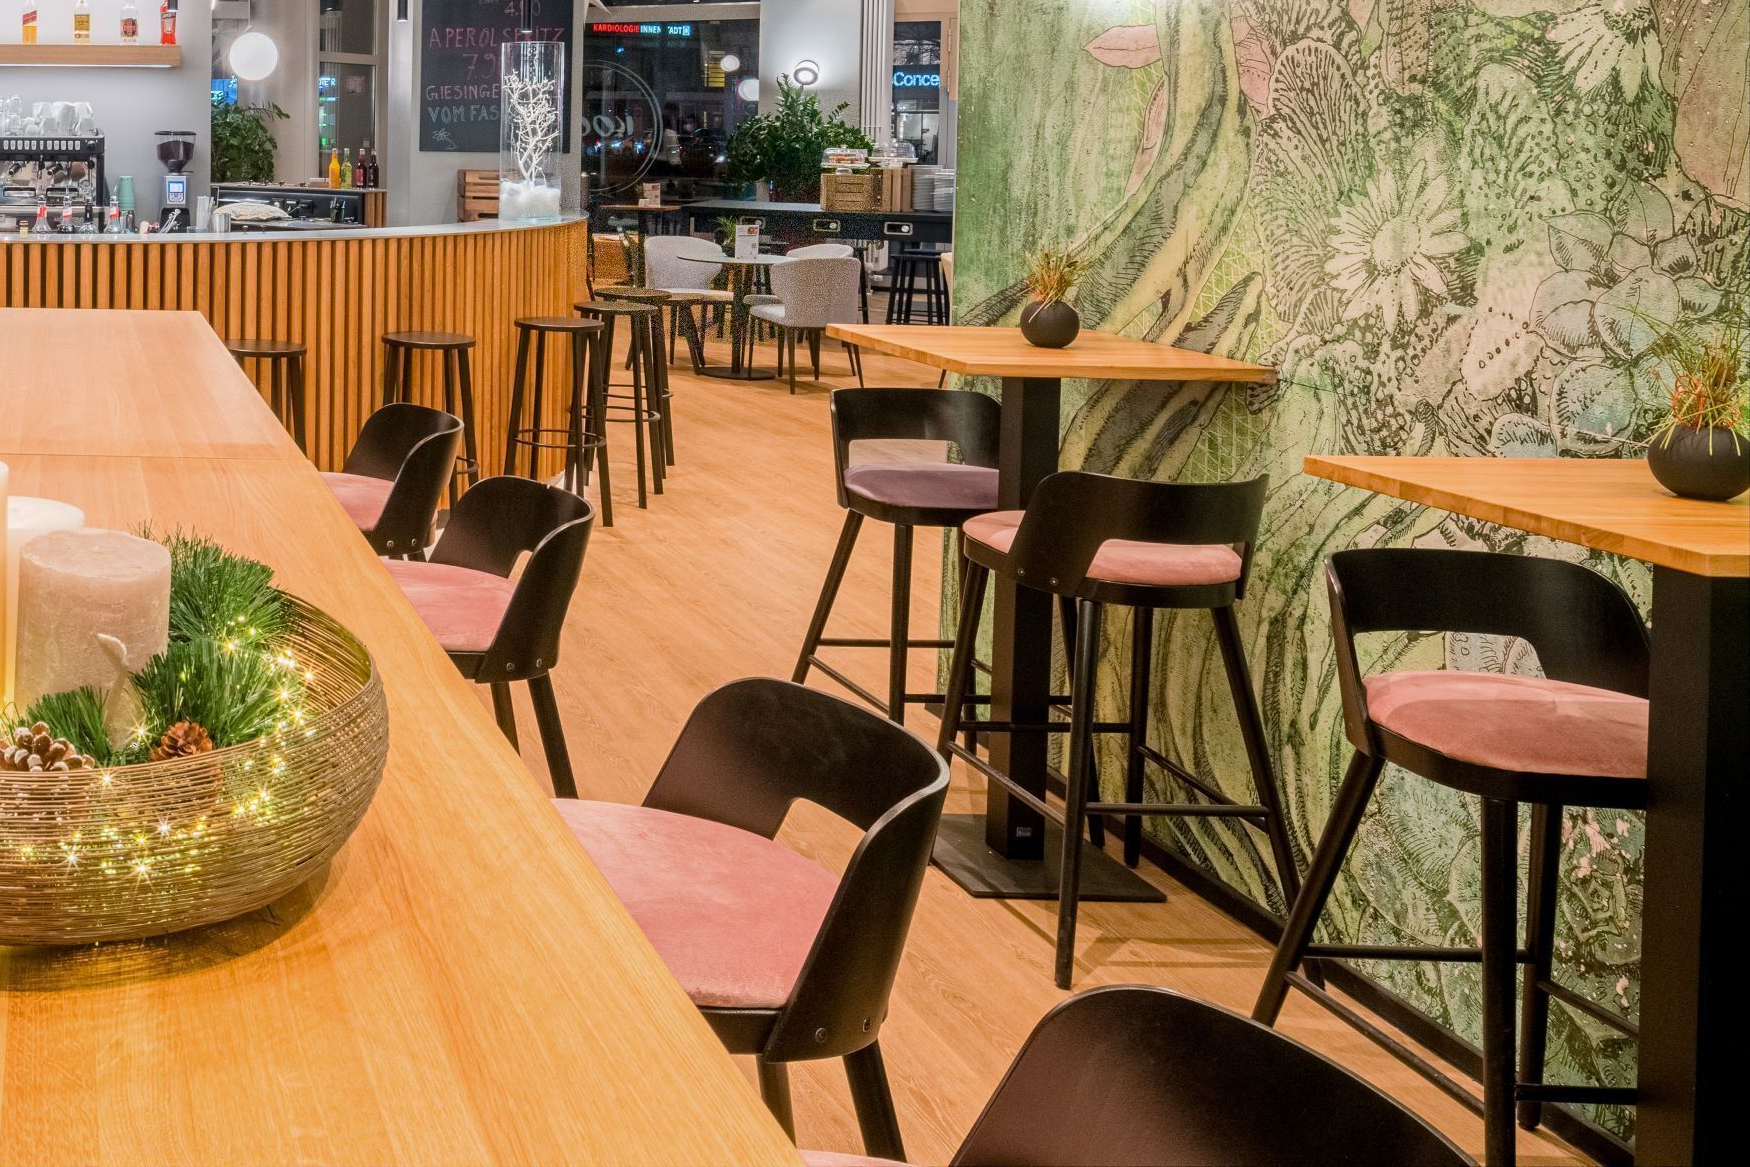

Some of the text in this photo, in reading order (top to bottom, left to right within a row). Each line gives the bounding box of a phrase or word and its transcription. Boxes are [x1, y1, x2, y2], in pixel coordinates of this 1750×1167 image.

[593, 23, 639, 33] KARDIOLOGIE
[893, 71, 940, 89] Conce
[426, 84, 500, 101] GIESINGE
[428, 105, 500, 124] VOM FAS
